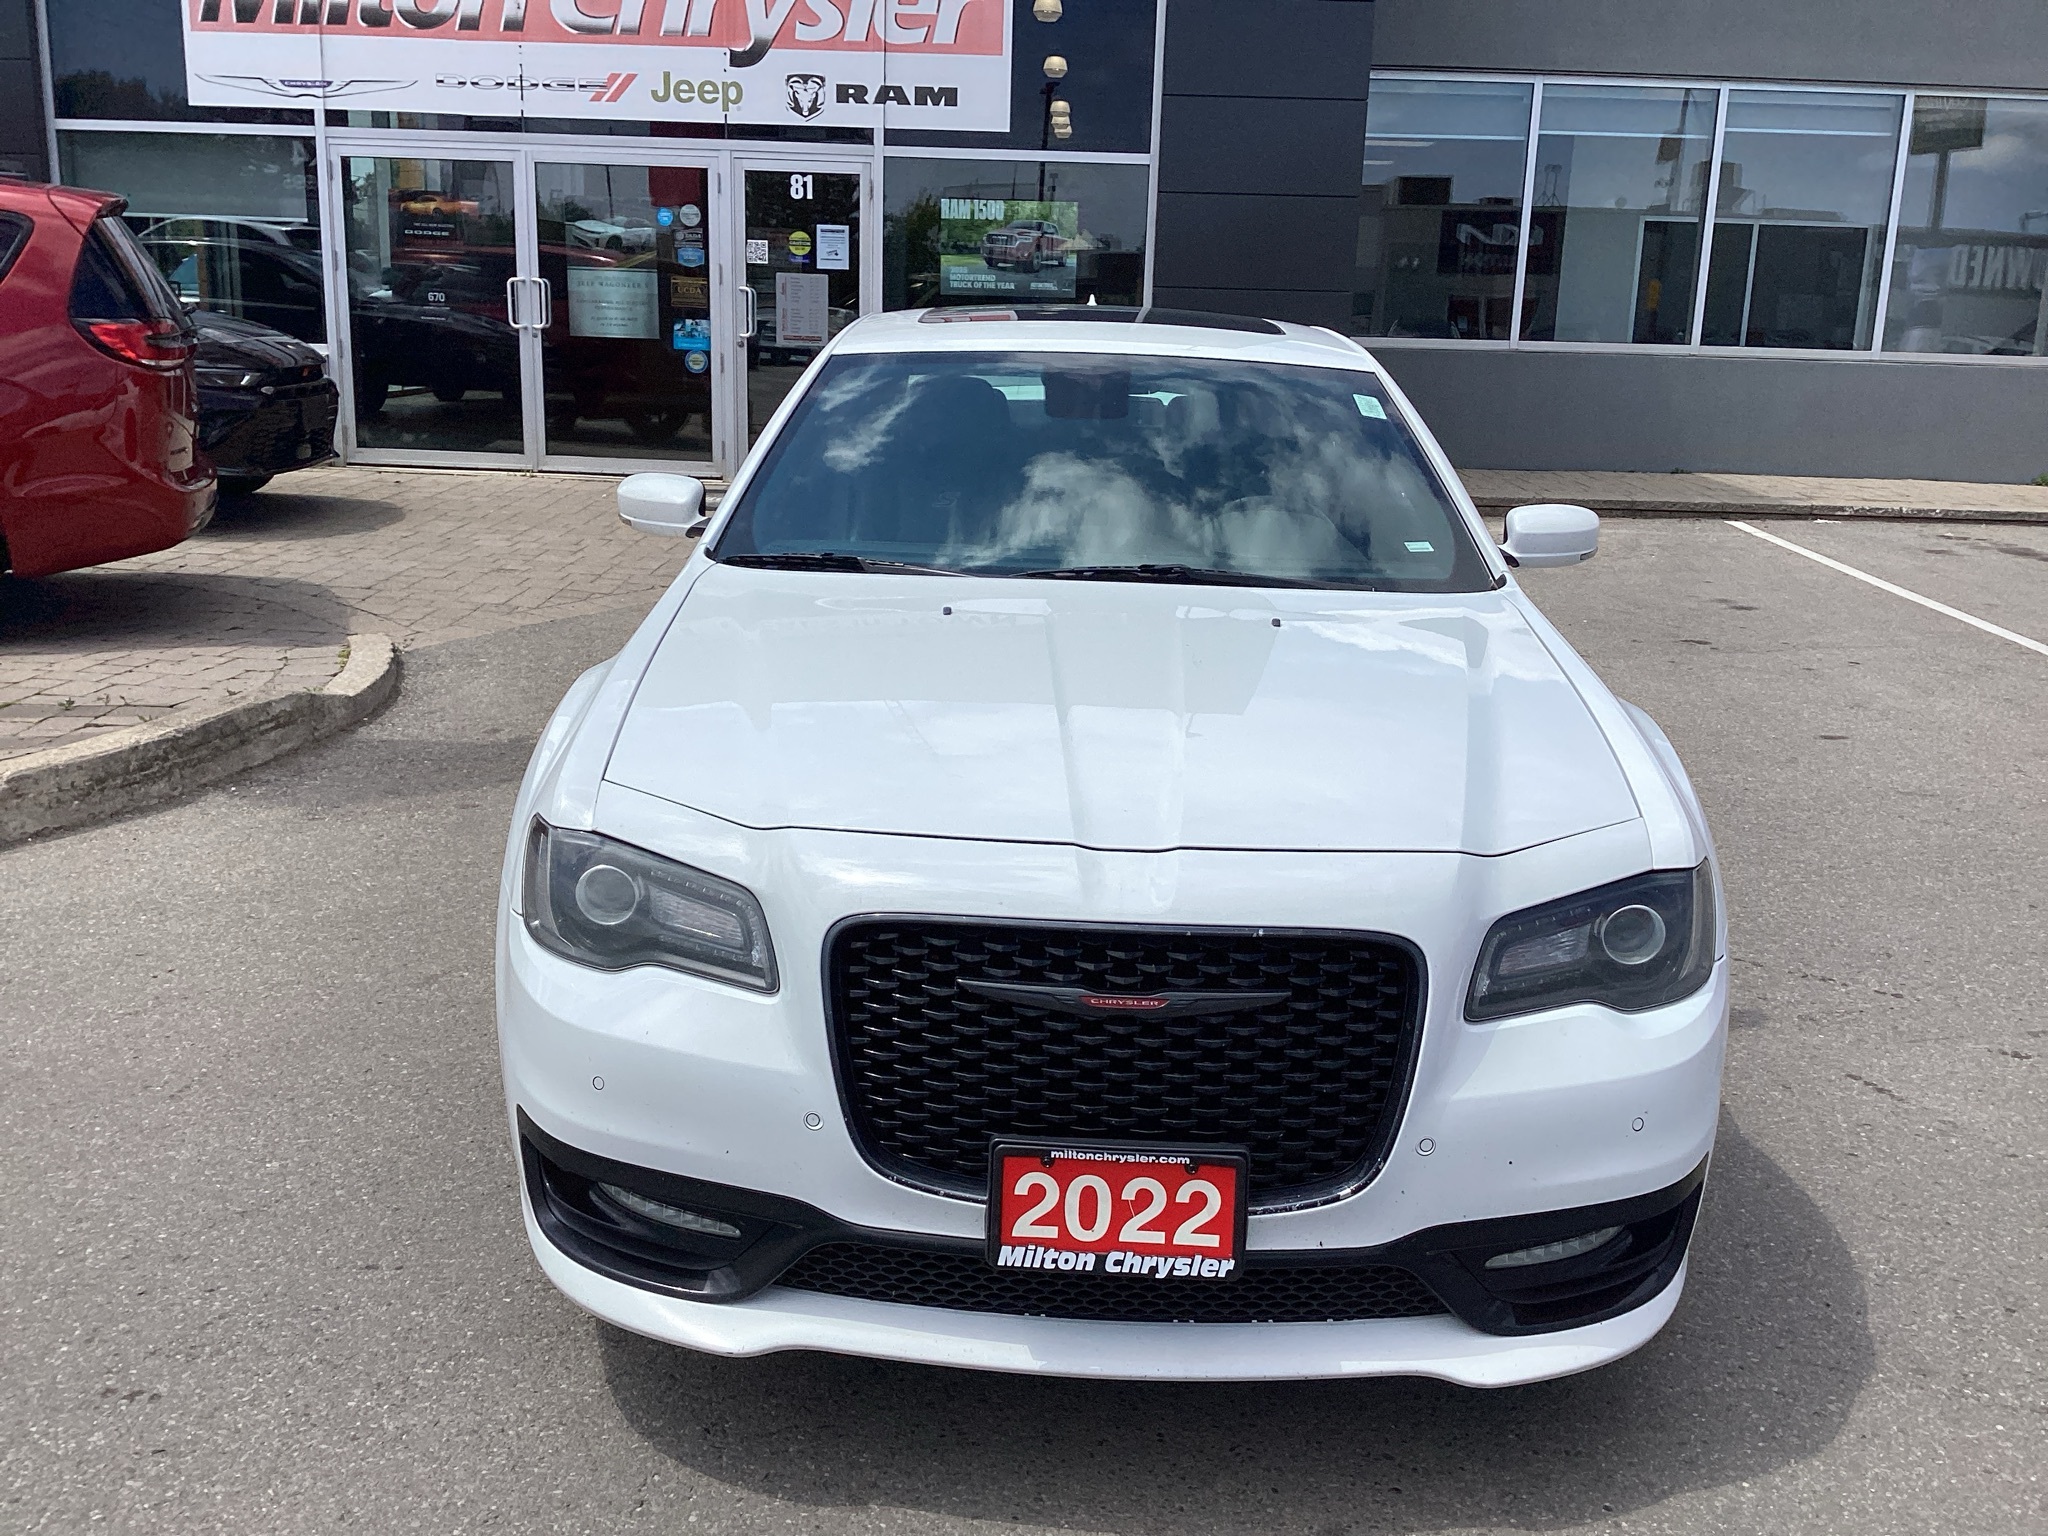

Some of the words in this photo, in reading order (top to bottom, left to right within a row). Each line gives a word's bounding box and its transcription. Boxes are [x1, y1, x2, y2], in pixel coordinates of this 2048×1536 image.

[436, 73, 609, 92] DODGE
[651, 71, 743, 112] Jeep
[836, 83, 958, 107] RAM
[790, 174, 813, 199] 81
[941, 199, 971, 219] RAM
[973, 200, 1005, 220] 1500
[404, 229, 450, 237] DODGE
[950, 273, 996, 282] MOTORTREND
[973, 281, 982, 289] OF
[982, 281, 995, 289] THE
[997, 282, 1015, 290] YEAR
[428, 292, 445, 302] 670
[1090, 998, 1159, 1006] CHRYSLER
[1050, 1149, 1190, 1166] miltonchrysler.com
[1011, 1171, 1222, 1248] 2022
[997, 1243, 1095, 1271] Milton
[1104, 1250, 1235, 1279] Chrysler
